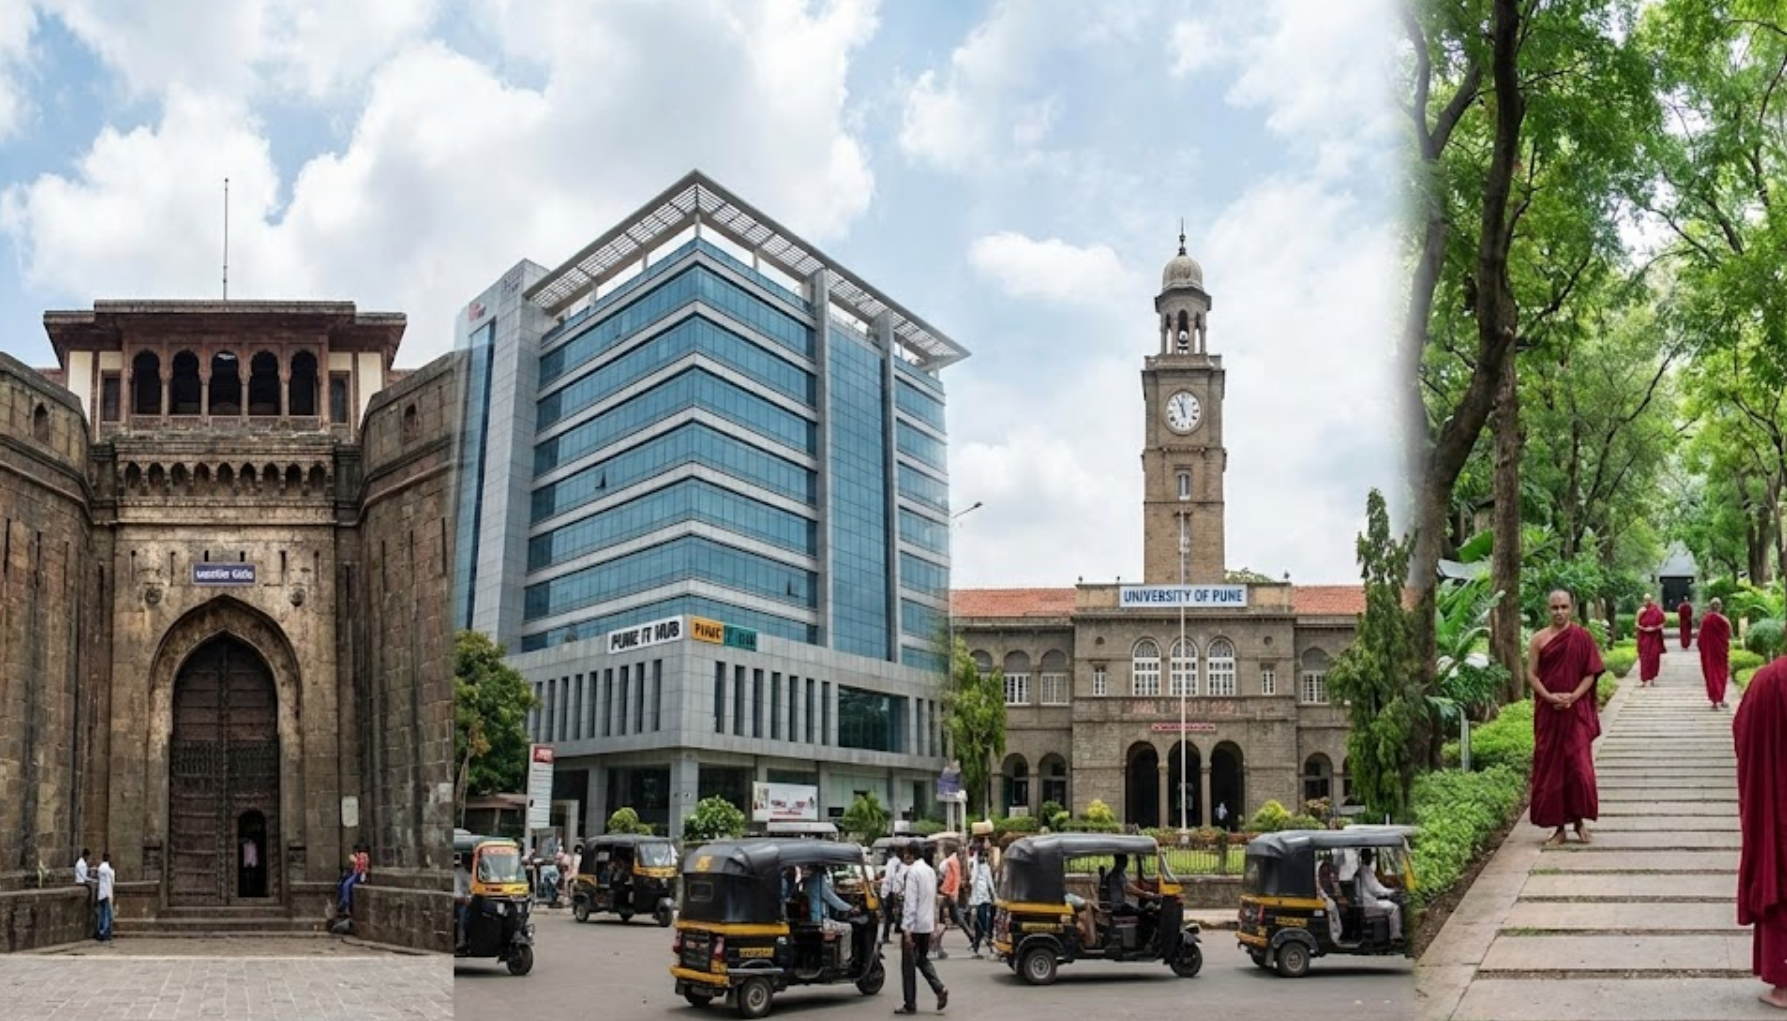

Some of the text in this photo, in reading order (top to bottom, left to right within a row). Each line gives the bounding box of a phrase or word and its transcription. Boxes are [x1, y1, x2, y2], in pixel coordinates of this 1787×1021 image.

[1124, 589, 1243, 602] UNIVERSITY OF PUNE
[641, 627, 652, 643] IT
